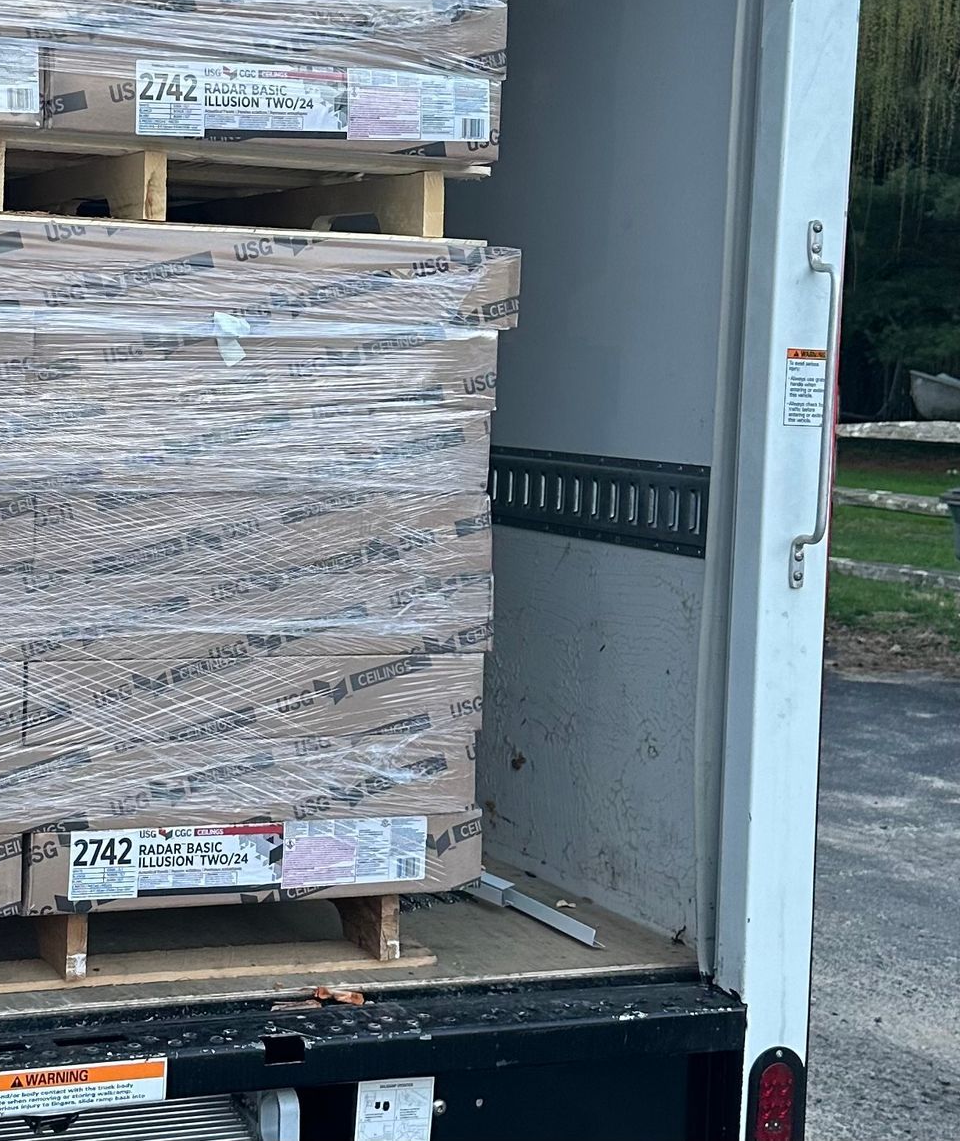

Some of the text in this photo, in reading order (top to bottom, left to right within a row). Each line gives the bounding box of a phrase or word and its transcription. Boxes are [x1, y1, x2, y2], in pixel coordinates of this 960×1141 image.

[204, 68, 221, 77] USG
[239, 69, 256, 78] CGC
[109, 81, 135, 103] US
[139, 72, 198, 102] 2742
[204, 82, 288, 96] RADAR BASIC
[204, 95, 314, 110] ILLUSION TWO/24
[44, 221, 87, 241] USG
[233, 237, 274, 262] USG
[412, 257, 450, 278] USG
[463, 371, 496, 395] USG
[358, 659, 412, 687] CEILINGS
[276, 690, 314, 713] USG
[450, 695, 483, 719] USG
[292, 795, 331, 819] USG
[140, 829, 157, 838] USG
[175, 829, 192, 837] CGC
[29, 841, 59, 863] SG
[73, 837, 132, 866] 2742
[139, 842, 223, 855] RADAR BASIC
[138, 853, 248, 868] ILLUSION TWO/24
[26, 1070, 88, 1086] WARNING
[29, 1094, 61, 1103] removing
